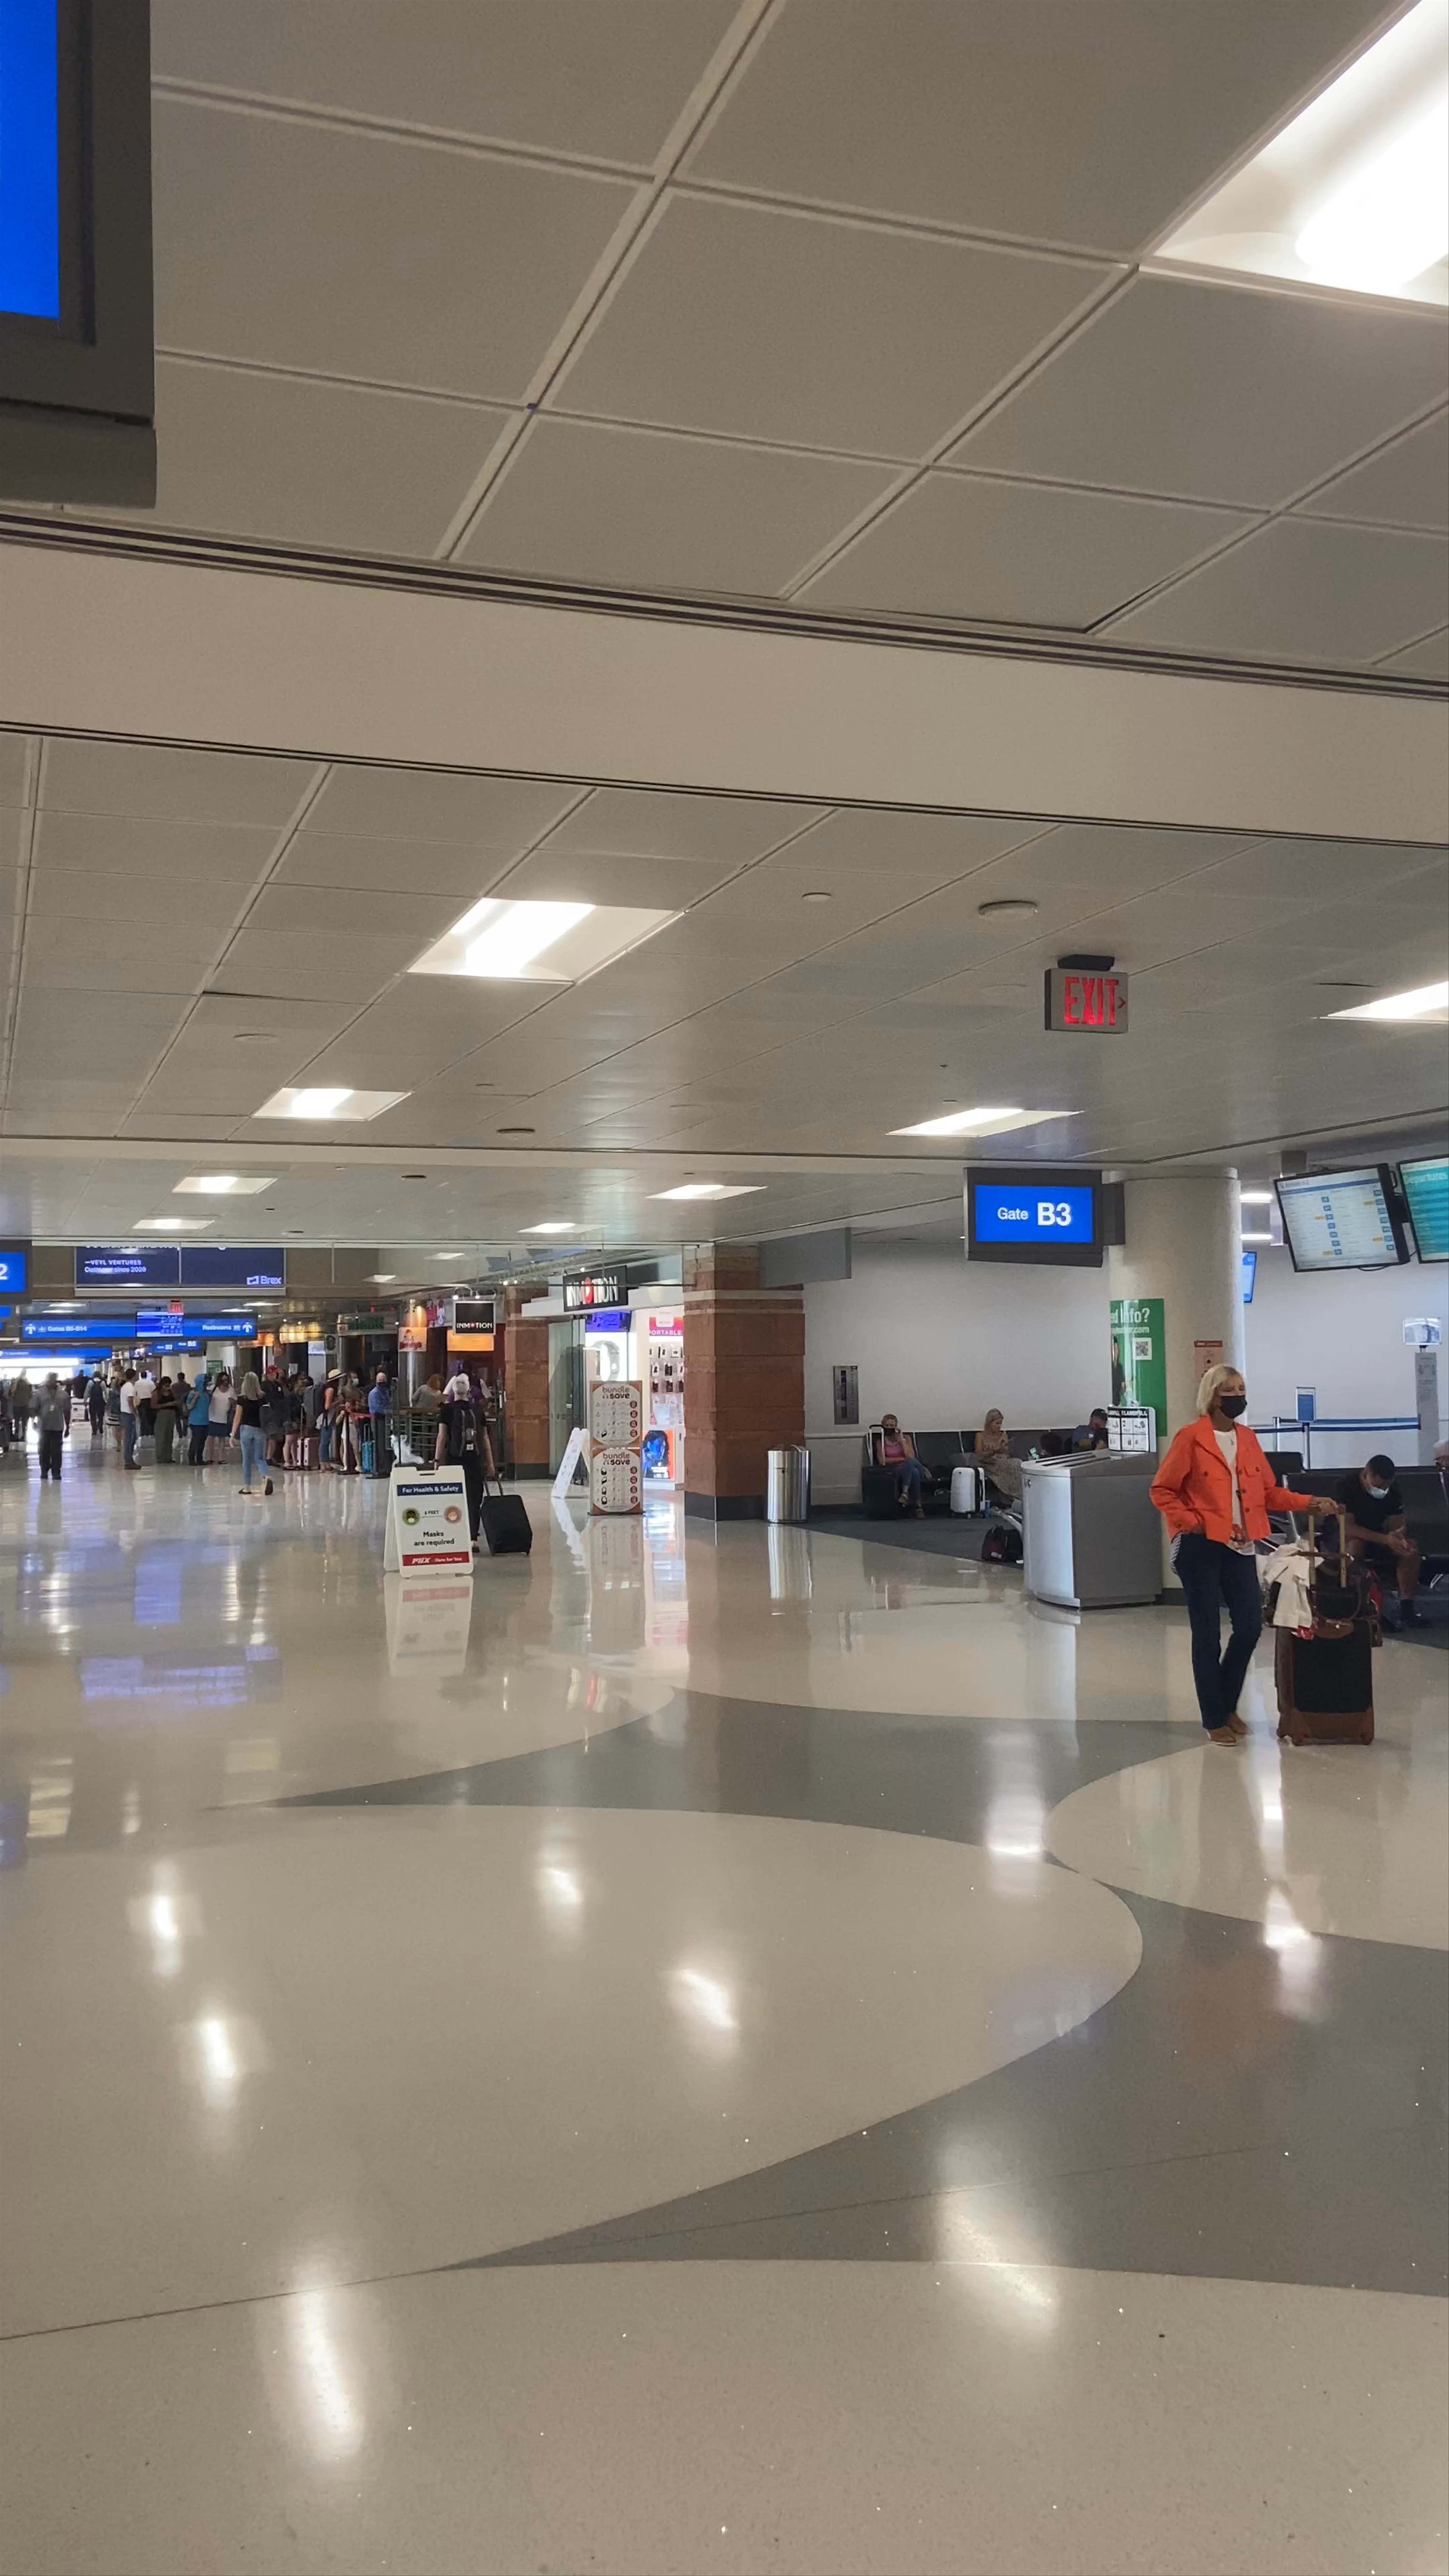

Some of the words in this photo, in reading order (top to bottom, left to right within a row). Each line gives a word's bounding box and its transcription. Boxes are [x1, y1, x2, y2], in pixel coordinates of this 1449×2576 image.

[1064, 977, 1119, 1025] EXIT
[997, 1207, 1029, 1220] Gate
[1037, 1202, 1071, 1226] B3
[261, 1276, 281, 1284] Brex
